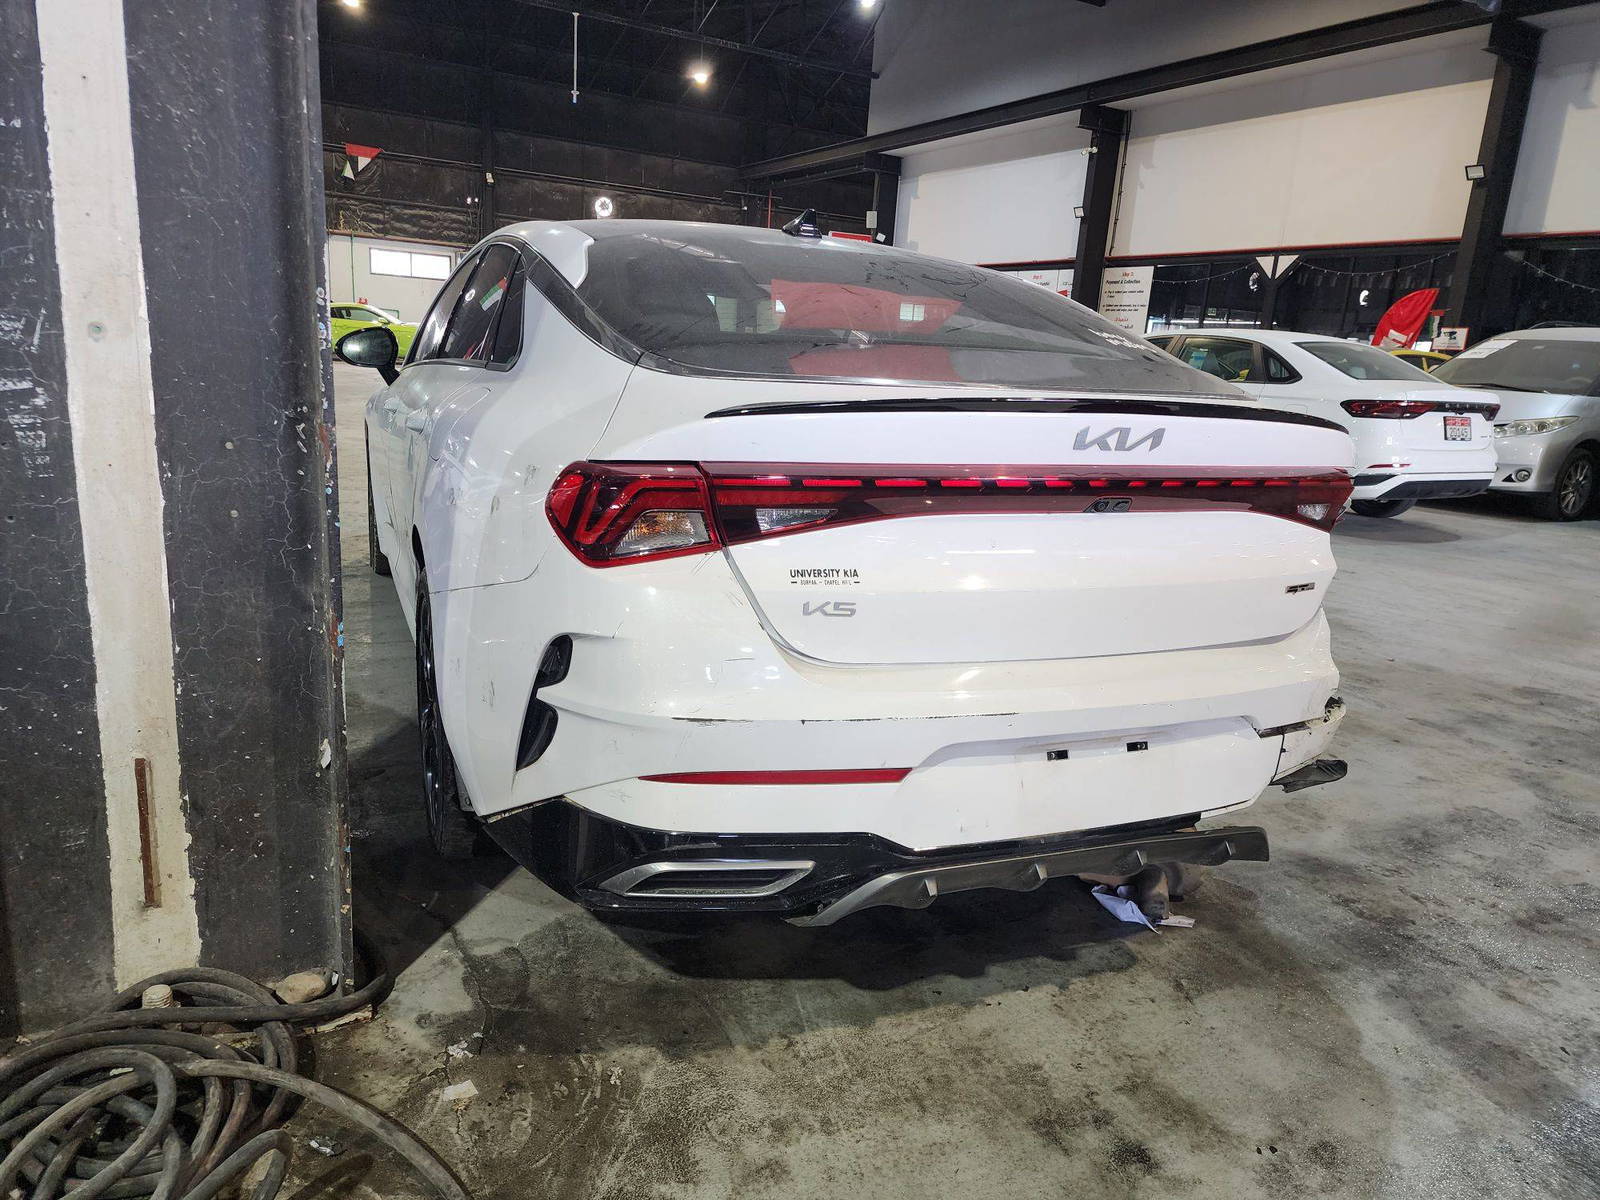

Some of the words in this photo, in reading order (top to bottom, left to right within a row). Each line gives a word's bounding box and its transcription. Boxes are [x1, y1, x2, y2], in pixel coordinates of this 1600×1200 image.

[1073, 426, 1166, 452] KIA
[789, 568, 840, 578] UNIVERSITY
[843, 568, 859, 578] KIA
[802, 600, 857, 617] K5
